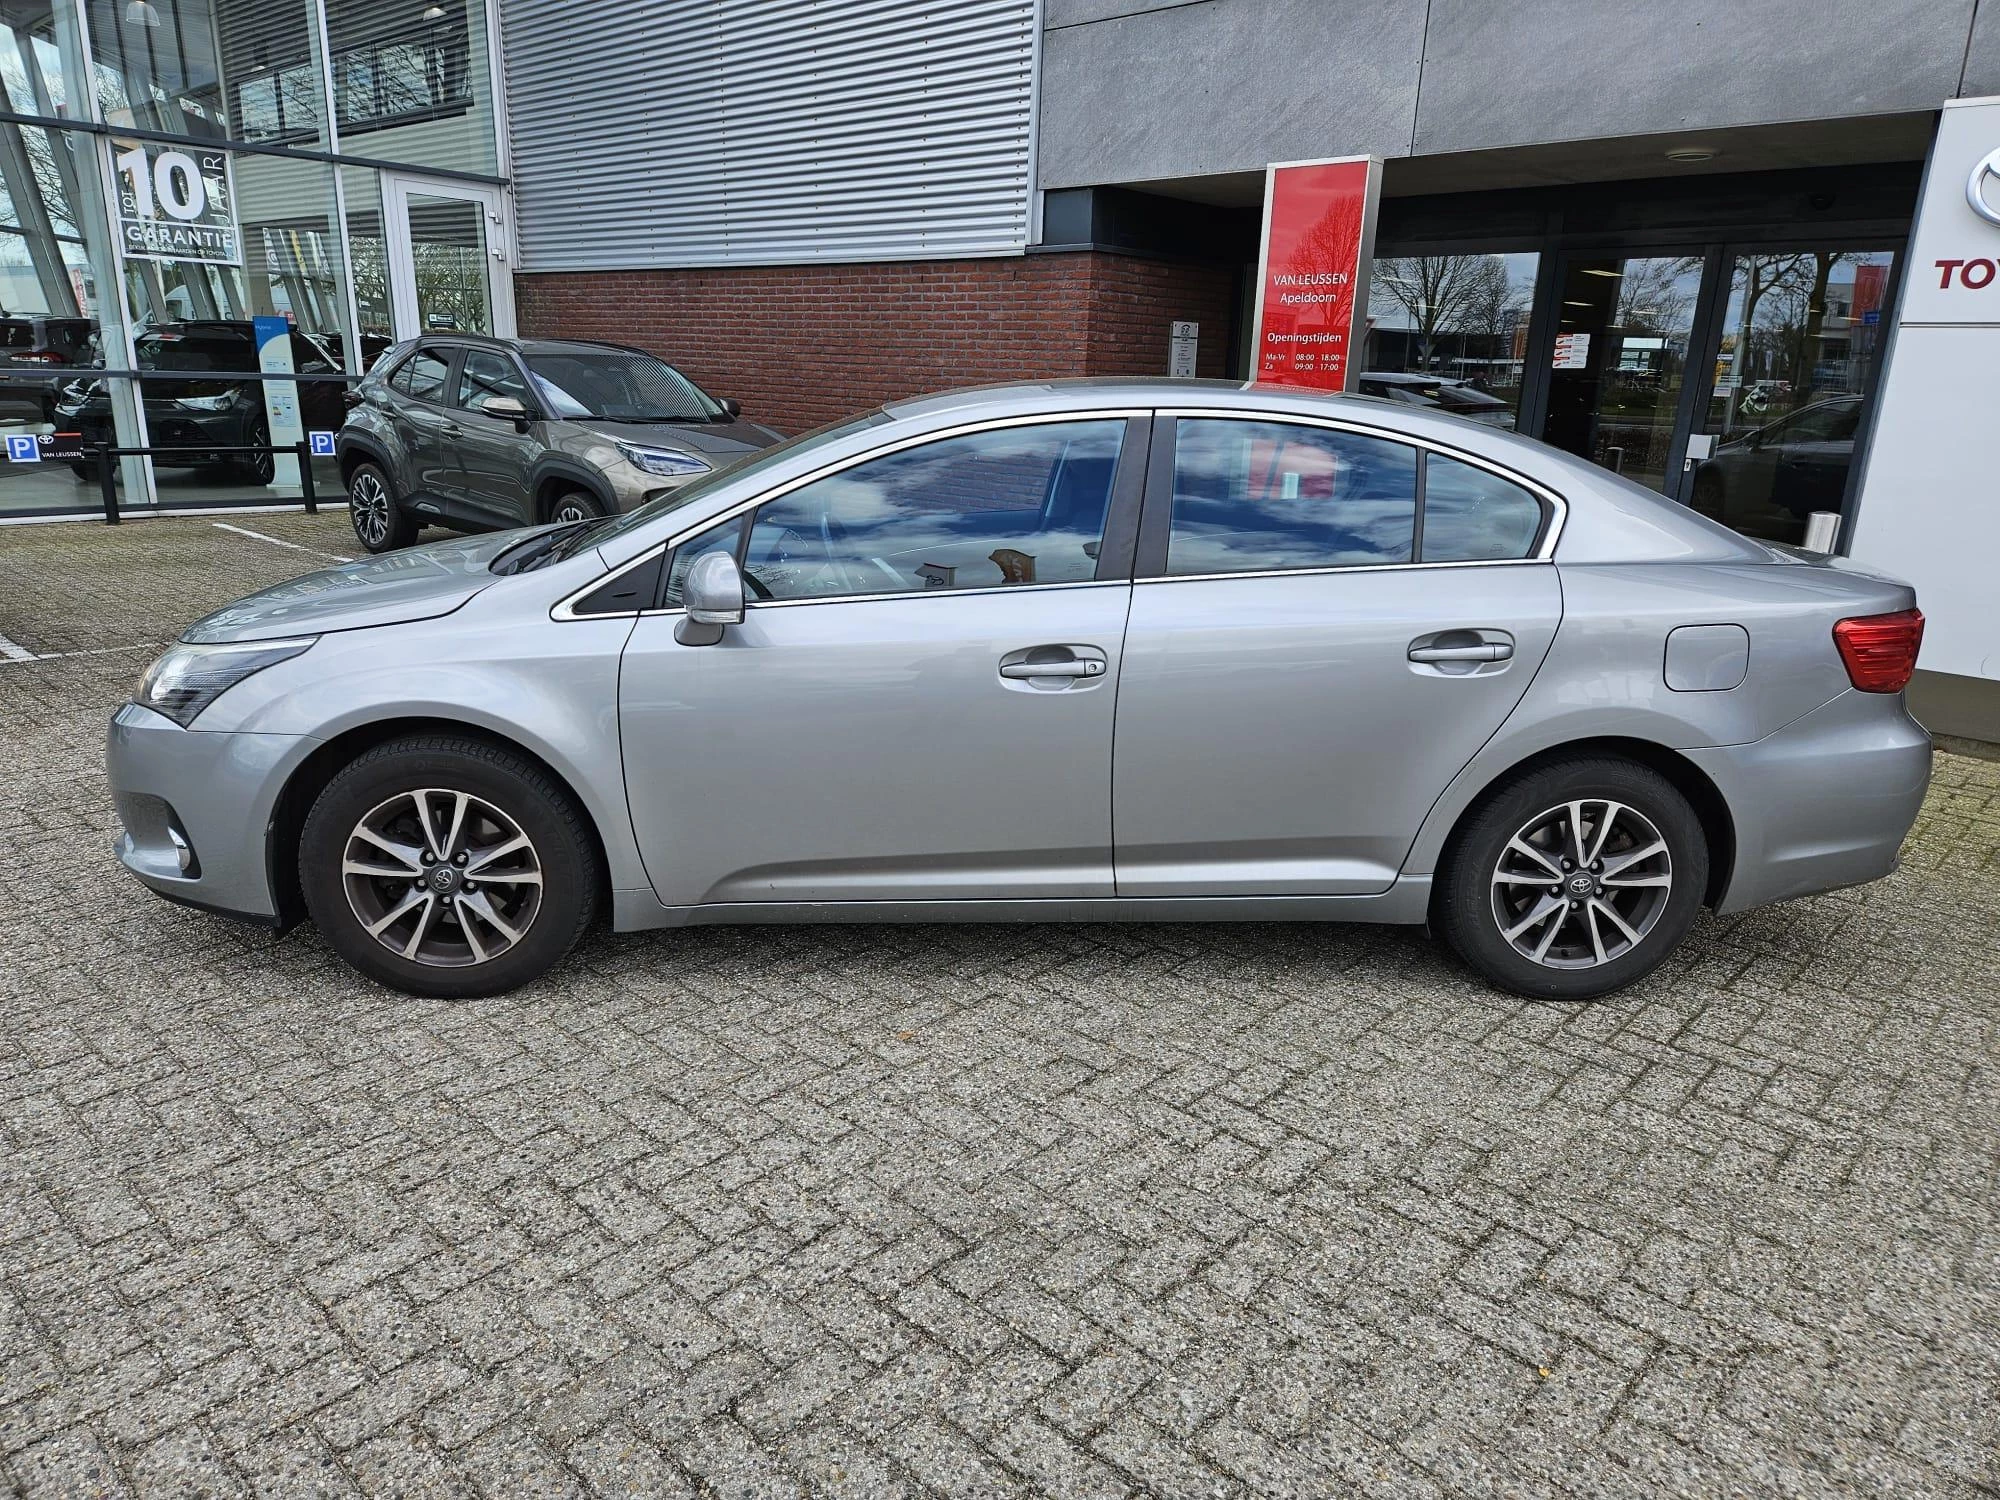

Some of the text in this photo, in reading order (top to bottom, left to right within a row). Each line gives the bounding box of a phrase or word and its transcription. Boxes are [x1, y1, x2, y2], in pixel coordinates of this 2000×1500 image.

[116, 148, 205, 220] 10
[122, 190, 135, 214] TOT
[127, 226, 233, 248] GARANTIE
[1273, 272, 1348, 286] VAN LEUSSEN
[1934, 258, 2000, 290] TO
[1279, 291, 1337, 305] Apeldoorn
[1267, 332, 1342, 345] Openingstijden
[1265, 352, 1286, 361] Ma-Vr
[1295, 353, 1315, 361] 08:00
[1321, 353, 1340, 361] 18:00
[1264, 362, 1274, 370] Za
[1294, 362, 1314, 370] 09:00
[1320, 363, 1339, 371] 17:00
[13, 438, 30, 458] P
[315, 435, 329, 452] P
